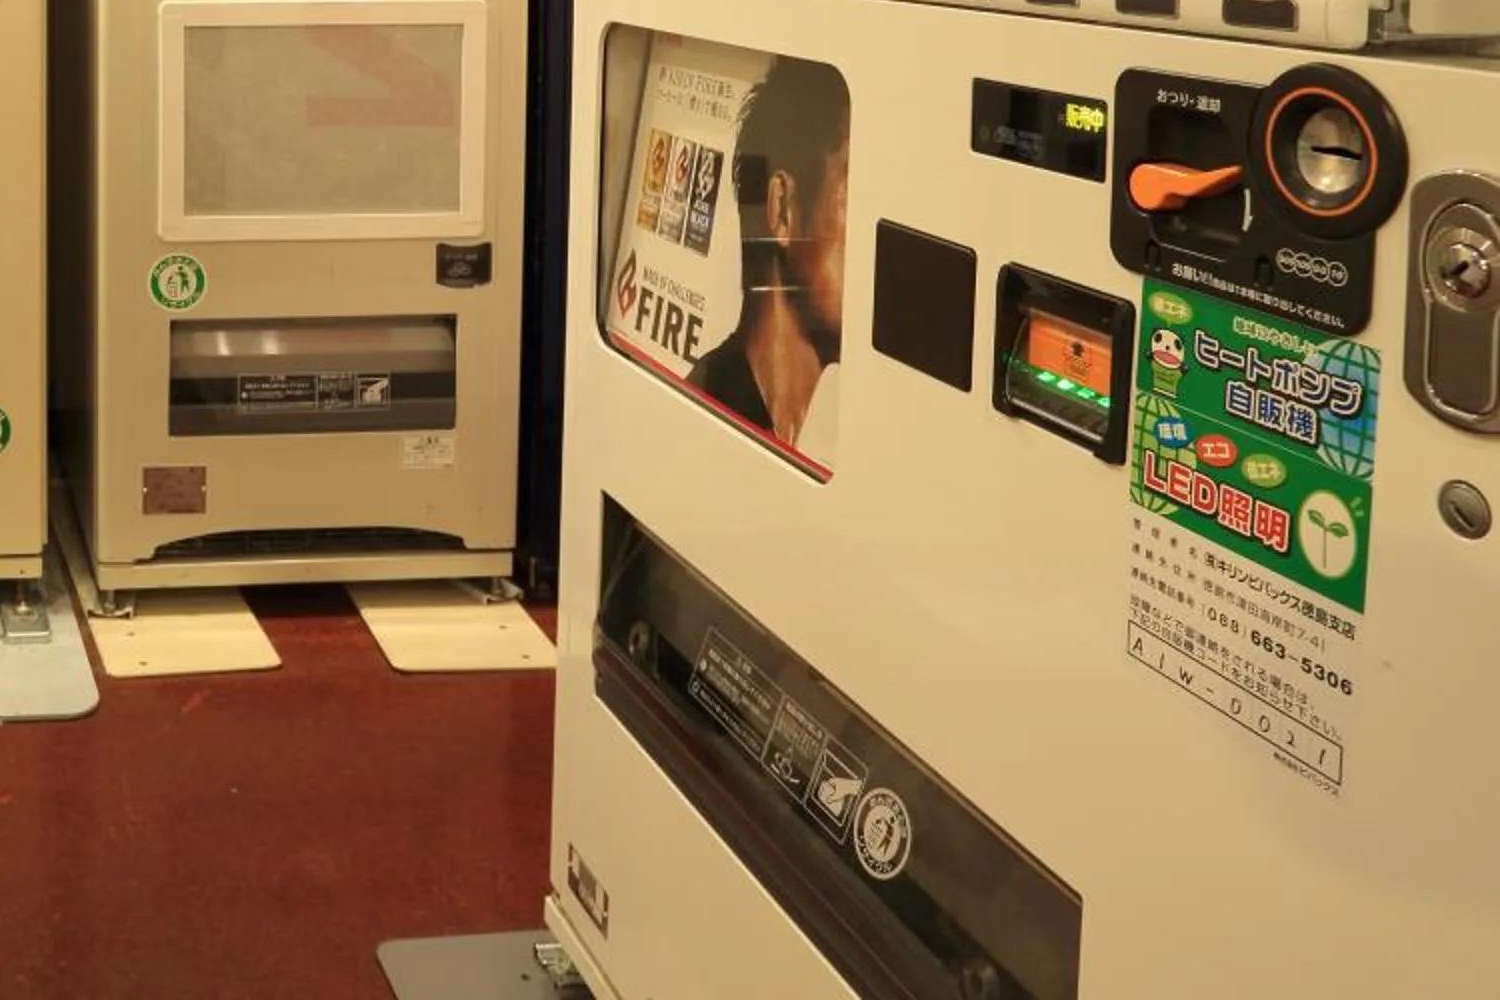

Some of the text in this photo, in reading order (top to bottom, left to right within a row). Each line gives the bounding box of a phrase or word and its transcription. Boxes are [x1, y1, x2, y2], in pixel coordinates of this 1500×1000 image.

[636, 285, 705, 367] FIRE
[1194, 329, 1363, 417] ヒートポンプ
[1225, 379, 1318, 445] 自販機
[1202, 440, 1232, 460] エコ
[1143, 448, 1290, 553] LED照明
